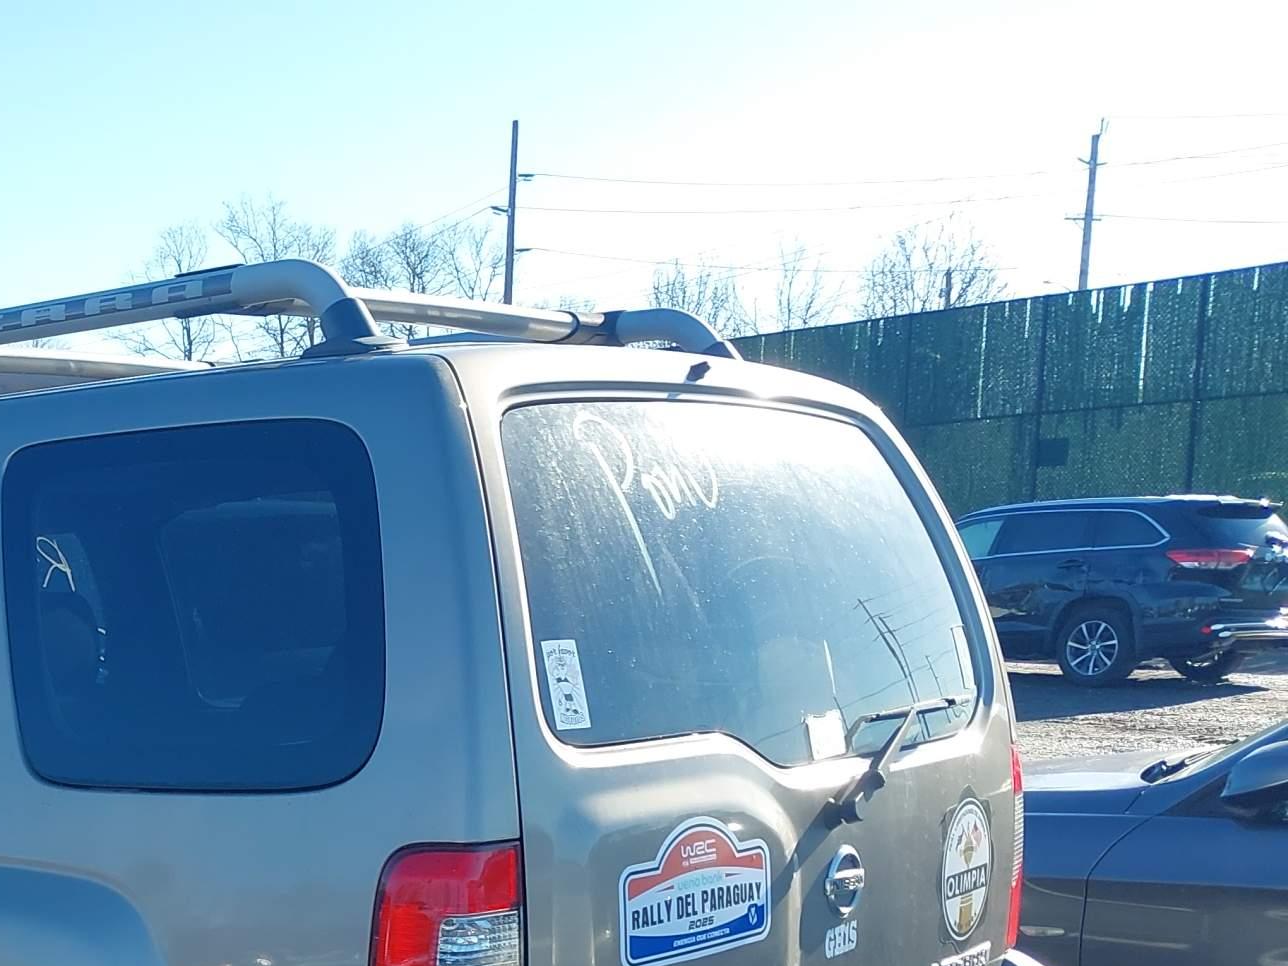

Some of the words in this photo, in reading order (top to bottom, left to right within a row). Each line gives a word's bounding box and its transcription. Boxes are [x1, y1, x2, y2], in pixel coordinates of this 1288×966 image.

[680, 839, 717, 858] WRC
[946, 866, 987, 897] OLIMPIA
[631, 898, 672, 930] RALLY
[676, 893, 698, 920] DEL
[701, 881, 762, 914] PARAGUAY
[688, 915, 715, 930] 2025
